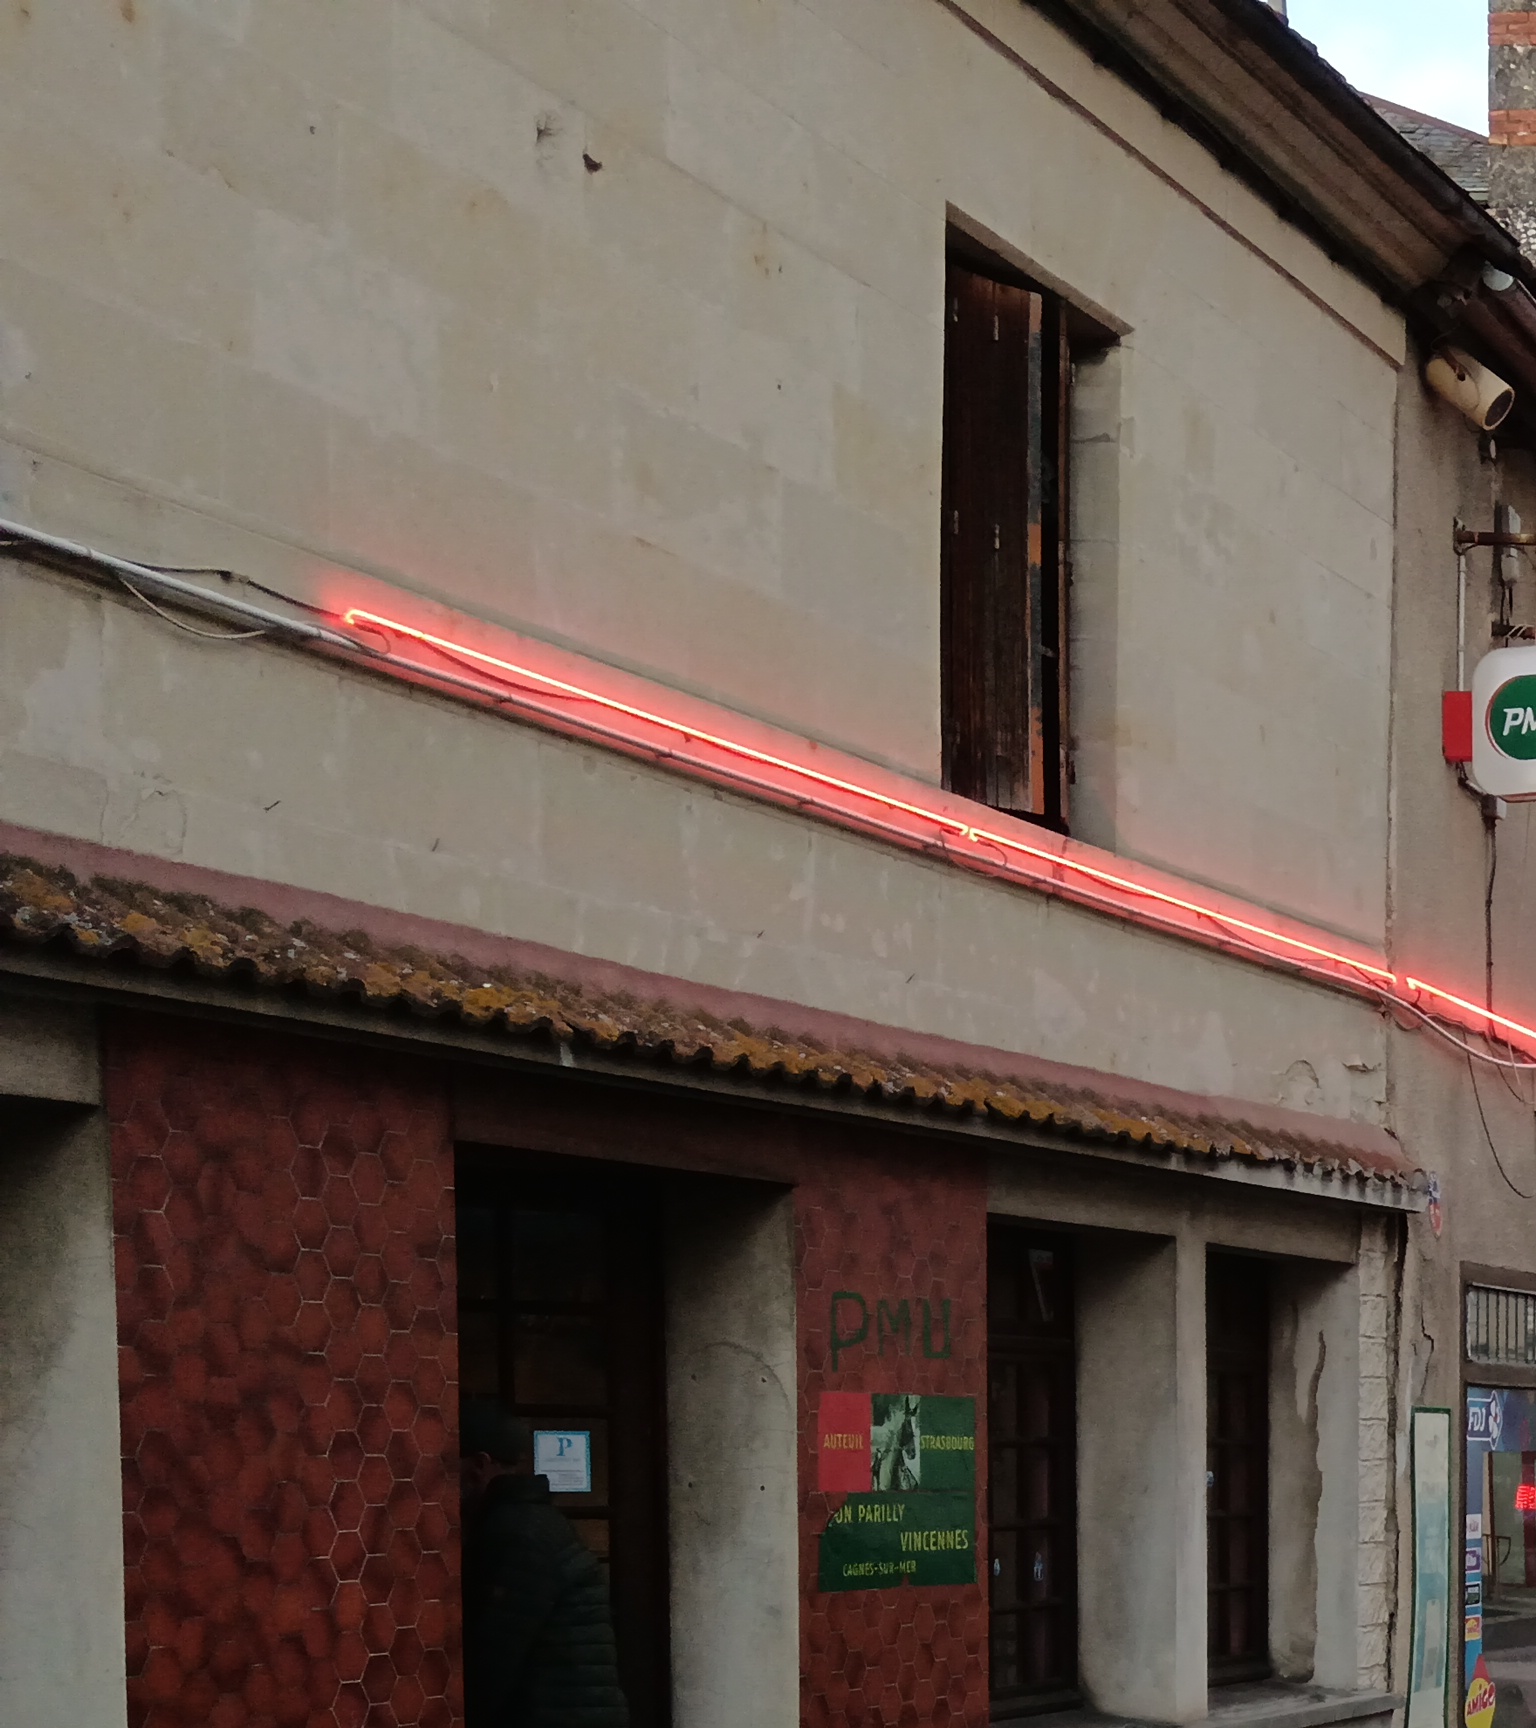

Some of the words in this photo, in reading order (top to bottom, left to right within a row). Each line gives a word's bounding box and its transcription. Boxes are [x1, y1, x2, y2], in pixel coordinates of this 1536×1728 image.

[829, 1291, 952, 1374] PMU
[1467, 1406, 1487, 1432] FDJ
[823, 1433, 865, 1450] AUTEUIL
[920, 1434, 975, 1451] STRASBOURG
[858, 1503, 906, 1524] PARILLY
[900, 1529, 969, 1552] VINCENNES
[842, 1561, 917, 1578] CAGNES-SUR-MER
